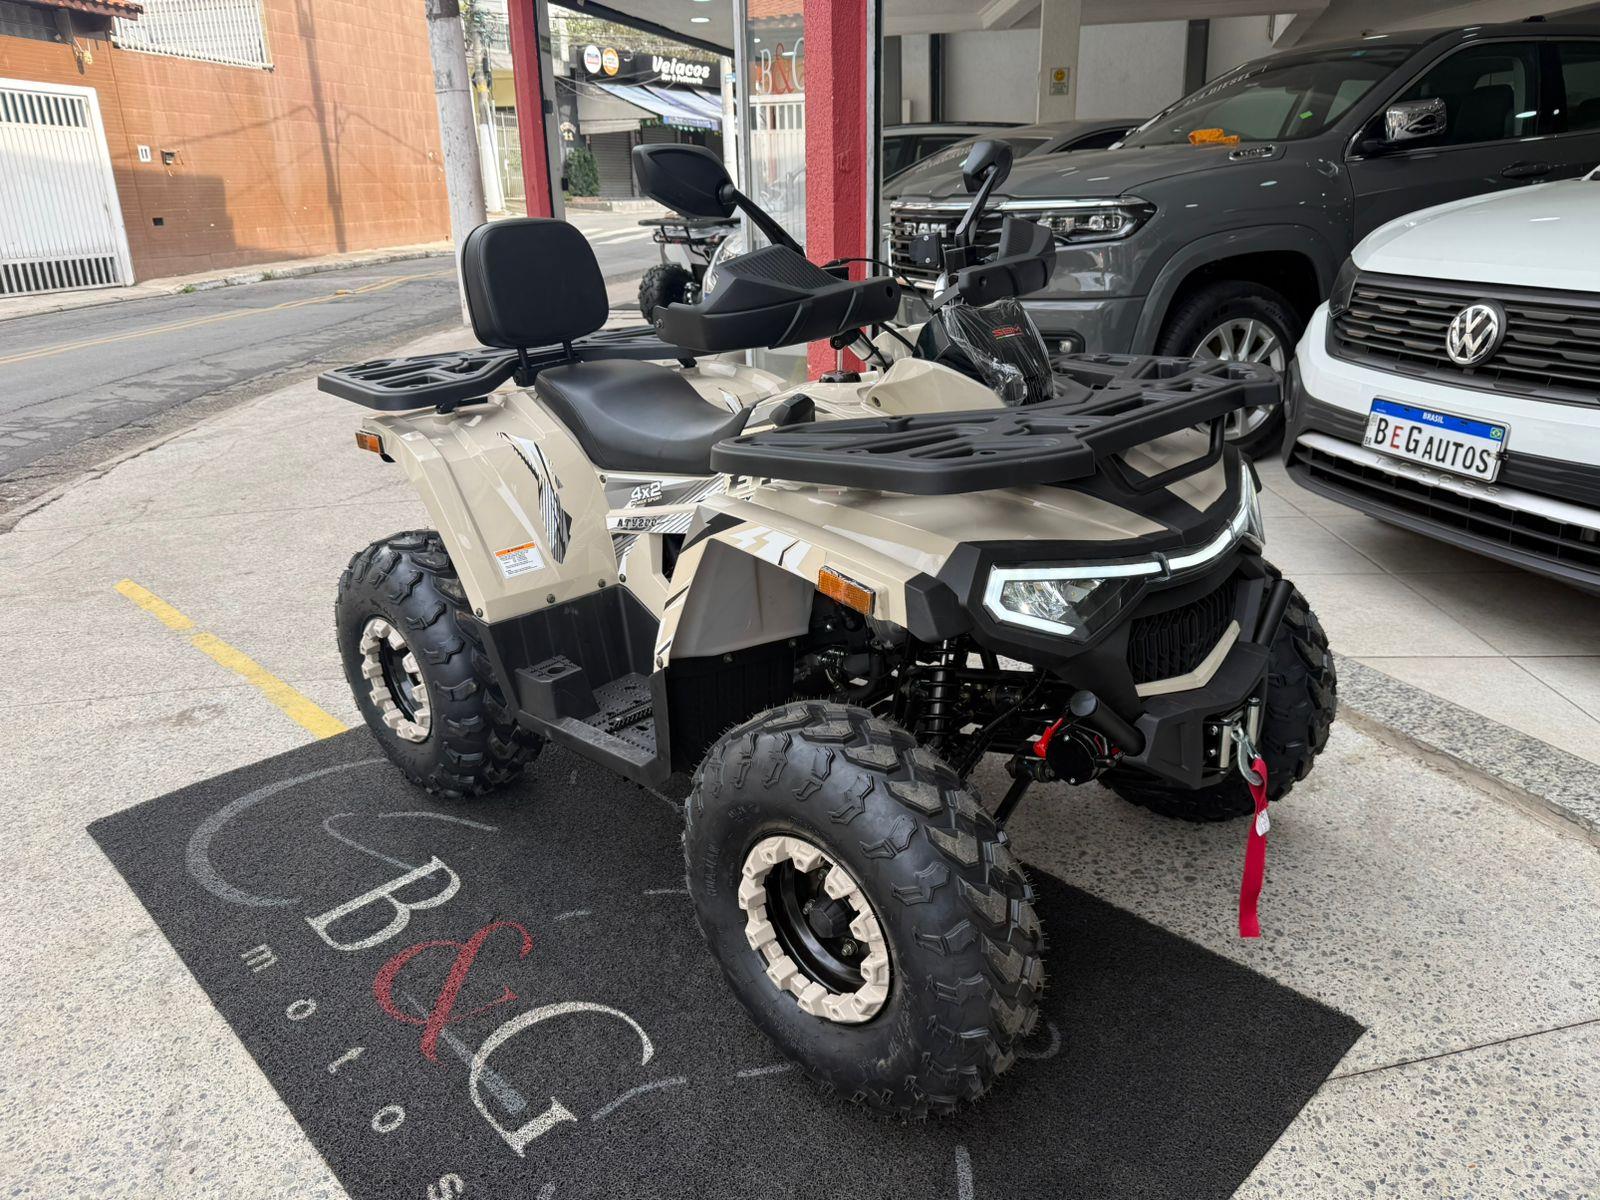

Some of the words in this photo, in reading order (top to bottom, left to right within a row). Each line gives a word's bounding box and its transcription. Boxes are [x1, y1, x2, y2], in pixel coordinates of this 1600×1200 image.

[904, 222, 947, 238] RAM
[1422, 411, 1445, 424] BRASIL
[631, 481, 661, 500] 4x2
